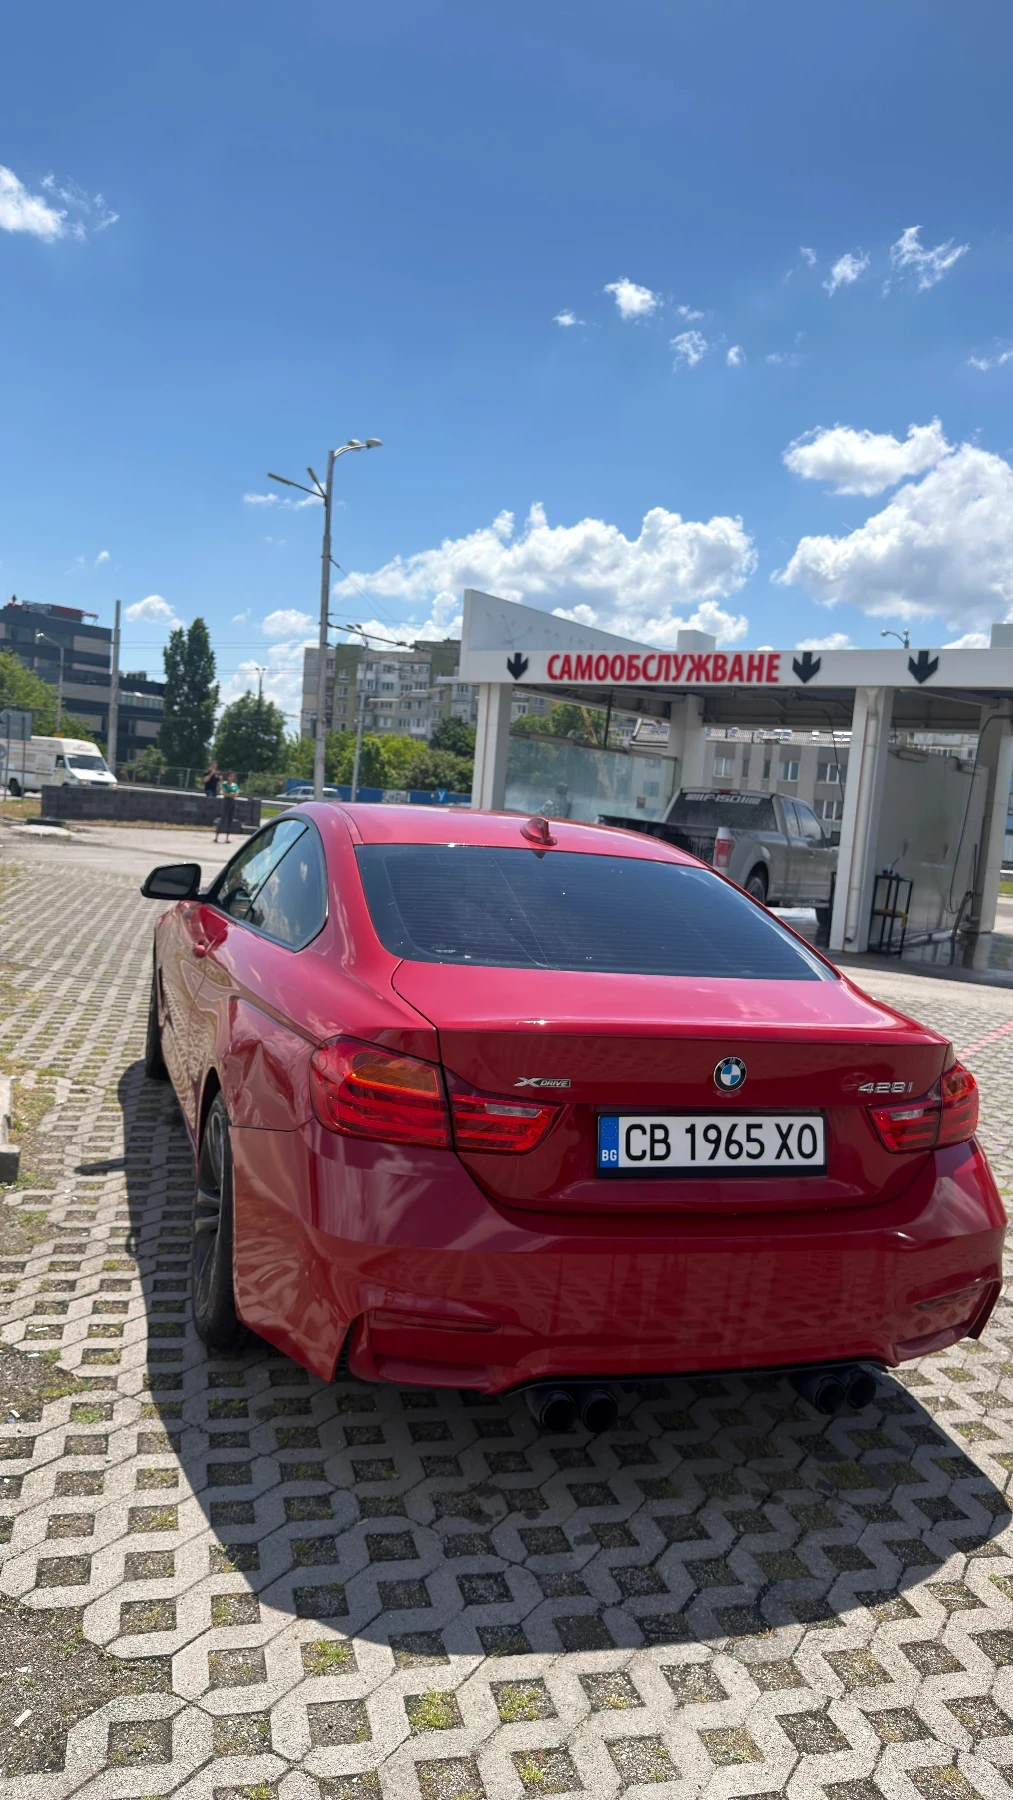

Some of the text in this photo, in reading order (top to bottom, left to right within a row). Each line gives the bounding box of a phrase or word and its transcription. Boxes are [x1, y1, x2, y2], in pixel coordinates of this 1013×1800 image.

[547, 653, 780, 683] САМООБСЛУЖВАНЕ
[858, 1082, 913, 1093] 428i
[625, 1123, 671, 1161] CB
[685, 1123, 765, 1161] 1965
[602, 1150, 617, 1162] BG
